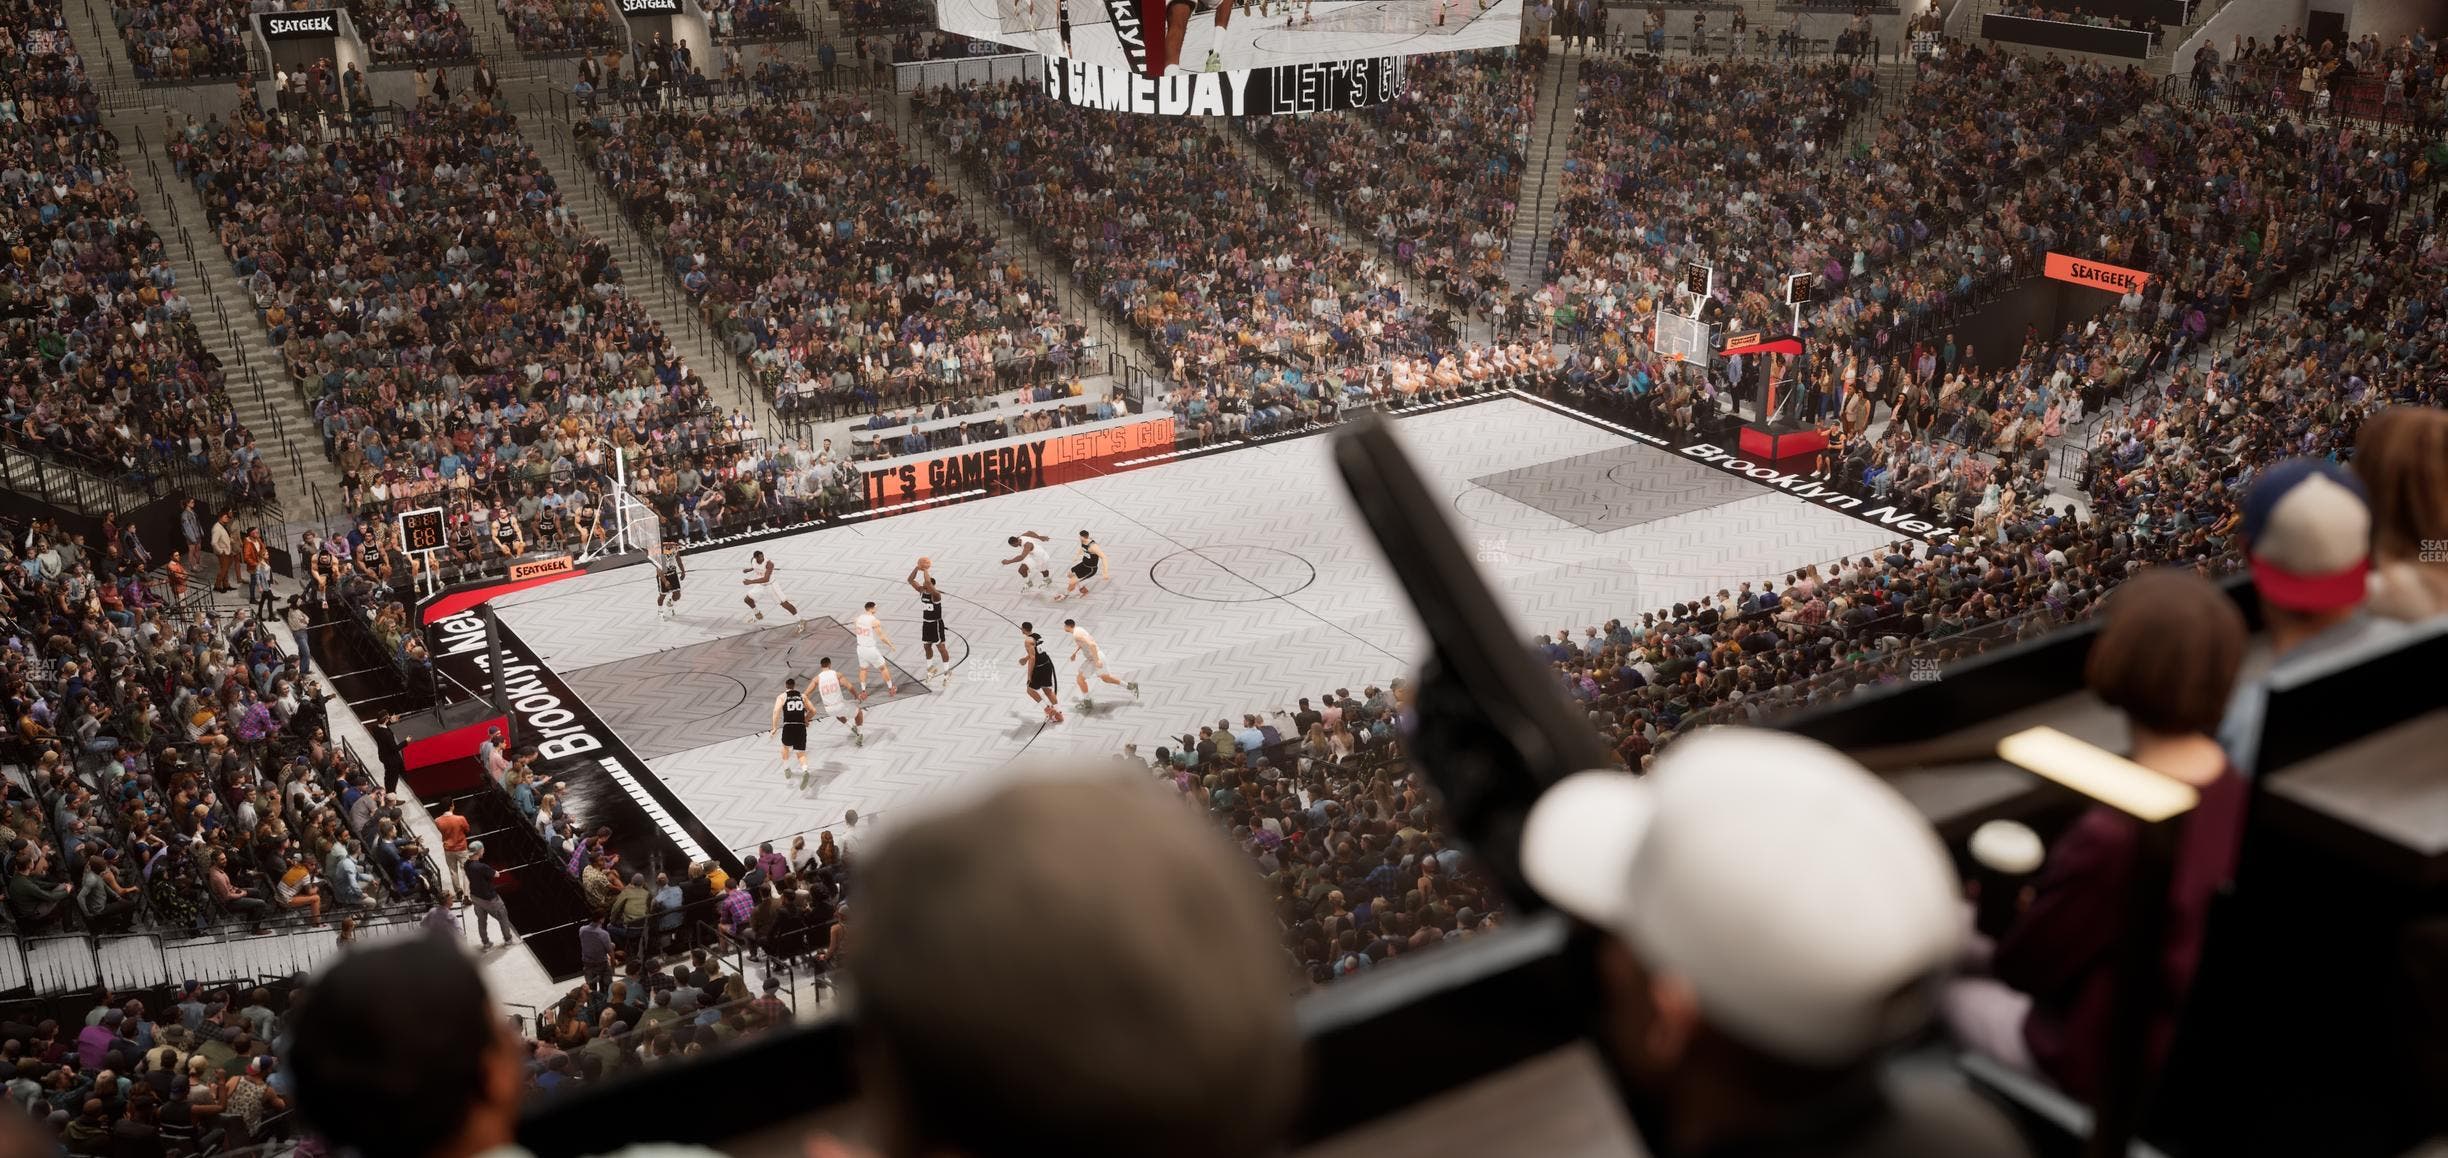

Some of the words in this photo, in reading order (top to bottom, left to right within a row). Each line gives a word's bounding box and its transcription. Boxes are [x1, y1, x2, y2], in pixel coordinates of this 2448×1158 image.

[270, 16, 333, 34] SEATGEEK
[1068, 58, 1250, 116] GAMEDAY
[1271, 57, 1368, 114] LET'S
[862, 464, 916, 499] IT'S
[929, 440, 1046, 489] GAMEDAY
[1057, 426, 1127, 463] LET'S
[1137, 416, 1176, 449] GO!
[1681, 443, 1863, 510] Brooklyn
[516, 560, 567, 578] SEATGEEK
